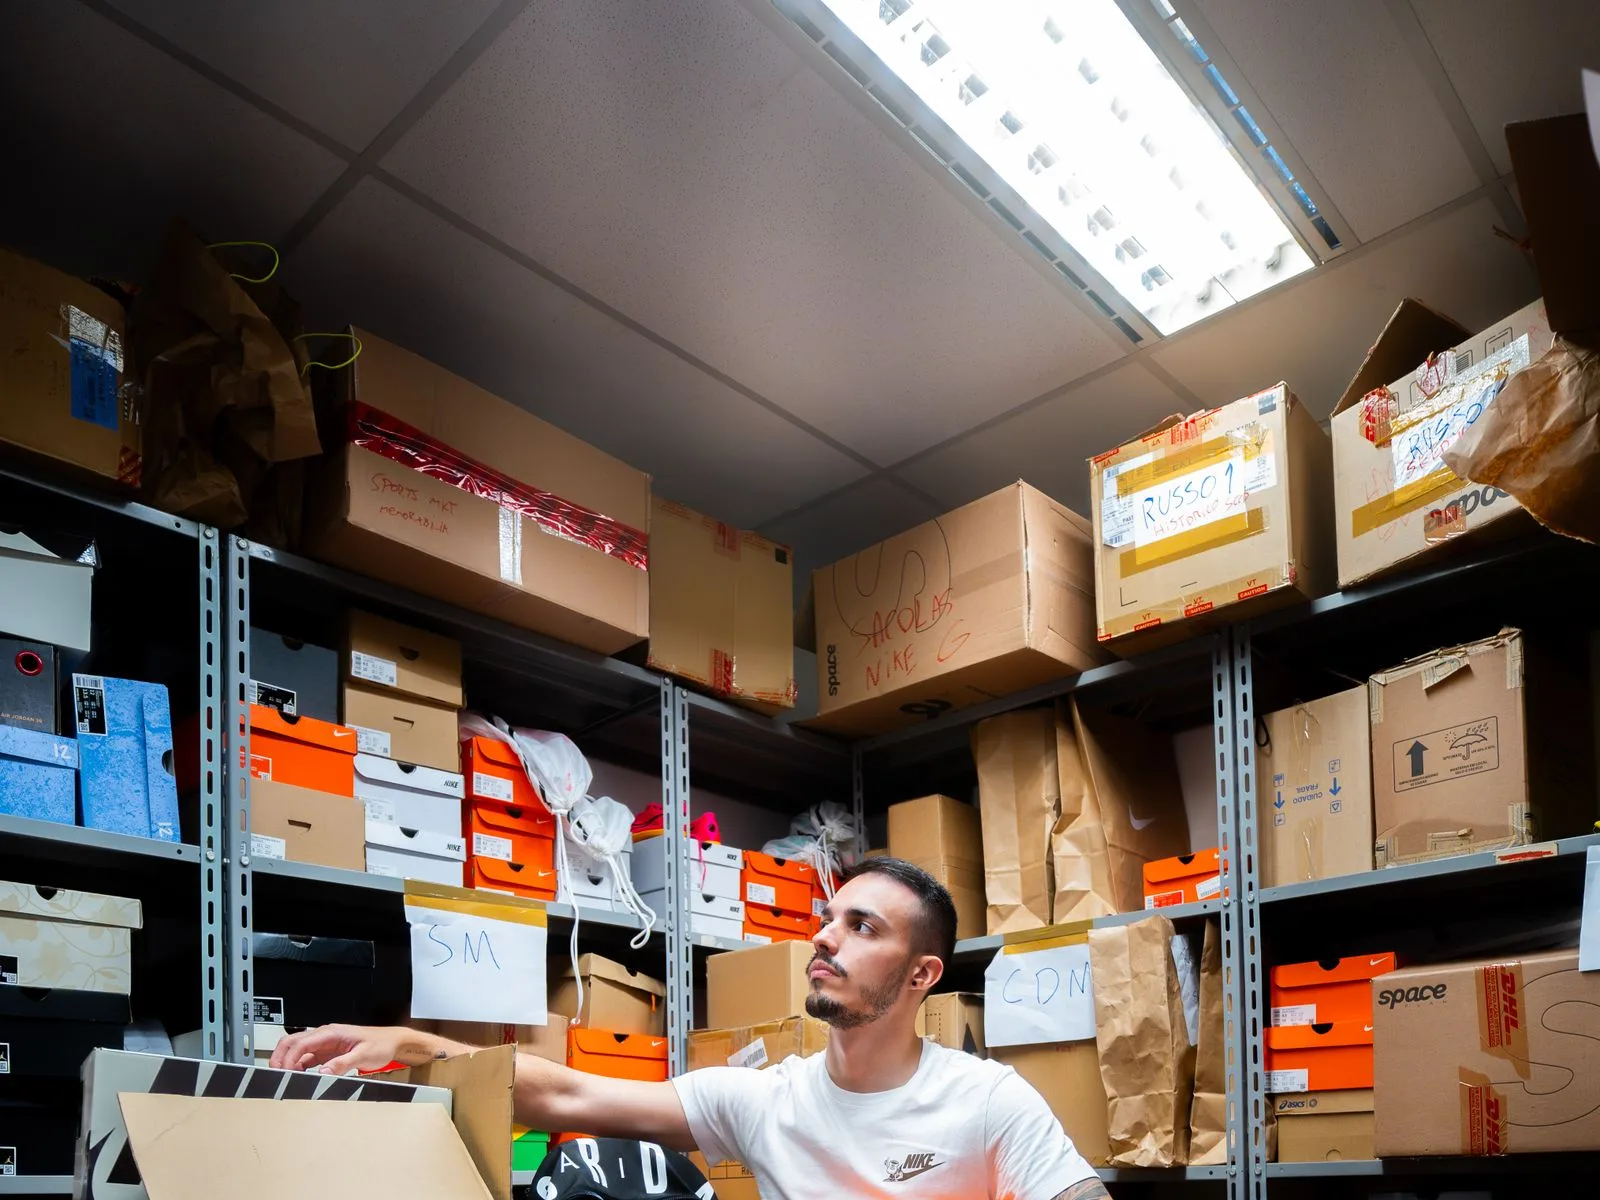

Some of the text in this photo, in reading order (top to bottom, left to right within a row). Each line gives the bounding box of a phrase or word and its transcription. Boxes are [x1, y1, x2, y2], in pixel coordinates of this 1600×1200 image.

[371, 472, 459, 514] SPORTS MKT
[1142, 475, 1217, 529] RUSSO
[1224, 462, 1234, 494] 1
[1239, 586, 1267, 599] CAUTION
[827, 644, 841, 696] space
[866, 643, 917, 690] NIKE
[12, 713, 33, 721] JORDAN
[53, 743, 72, 760] 12
[443, 780, 459, 789] NIKE
[1292, 792, 1323, 805] CUIDADO
[158, 822, 173, 838] 12
[447, 843, 461, 853] NIKE
[727, 853, 738, 861] NIKE
[1378, 983, 1447, 1009] space
[1501, 972, 1519, 1035] DHL
[1287, 1101, 1305, 1109] asics
[903, 1153, 935, 1169] NIKE
